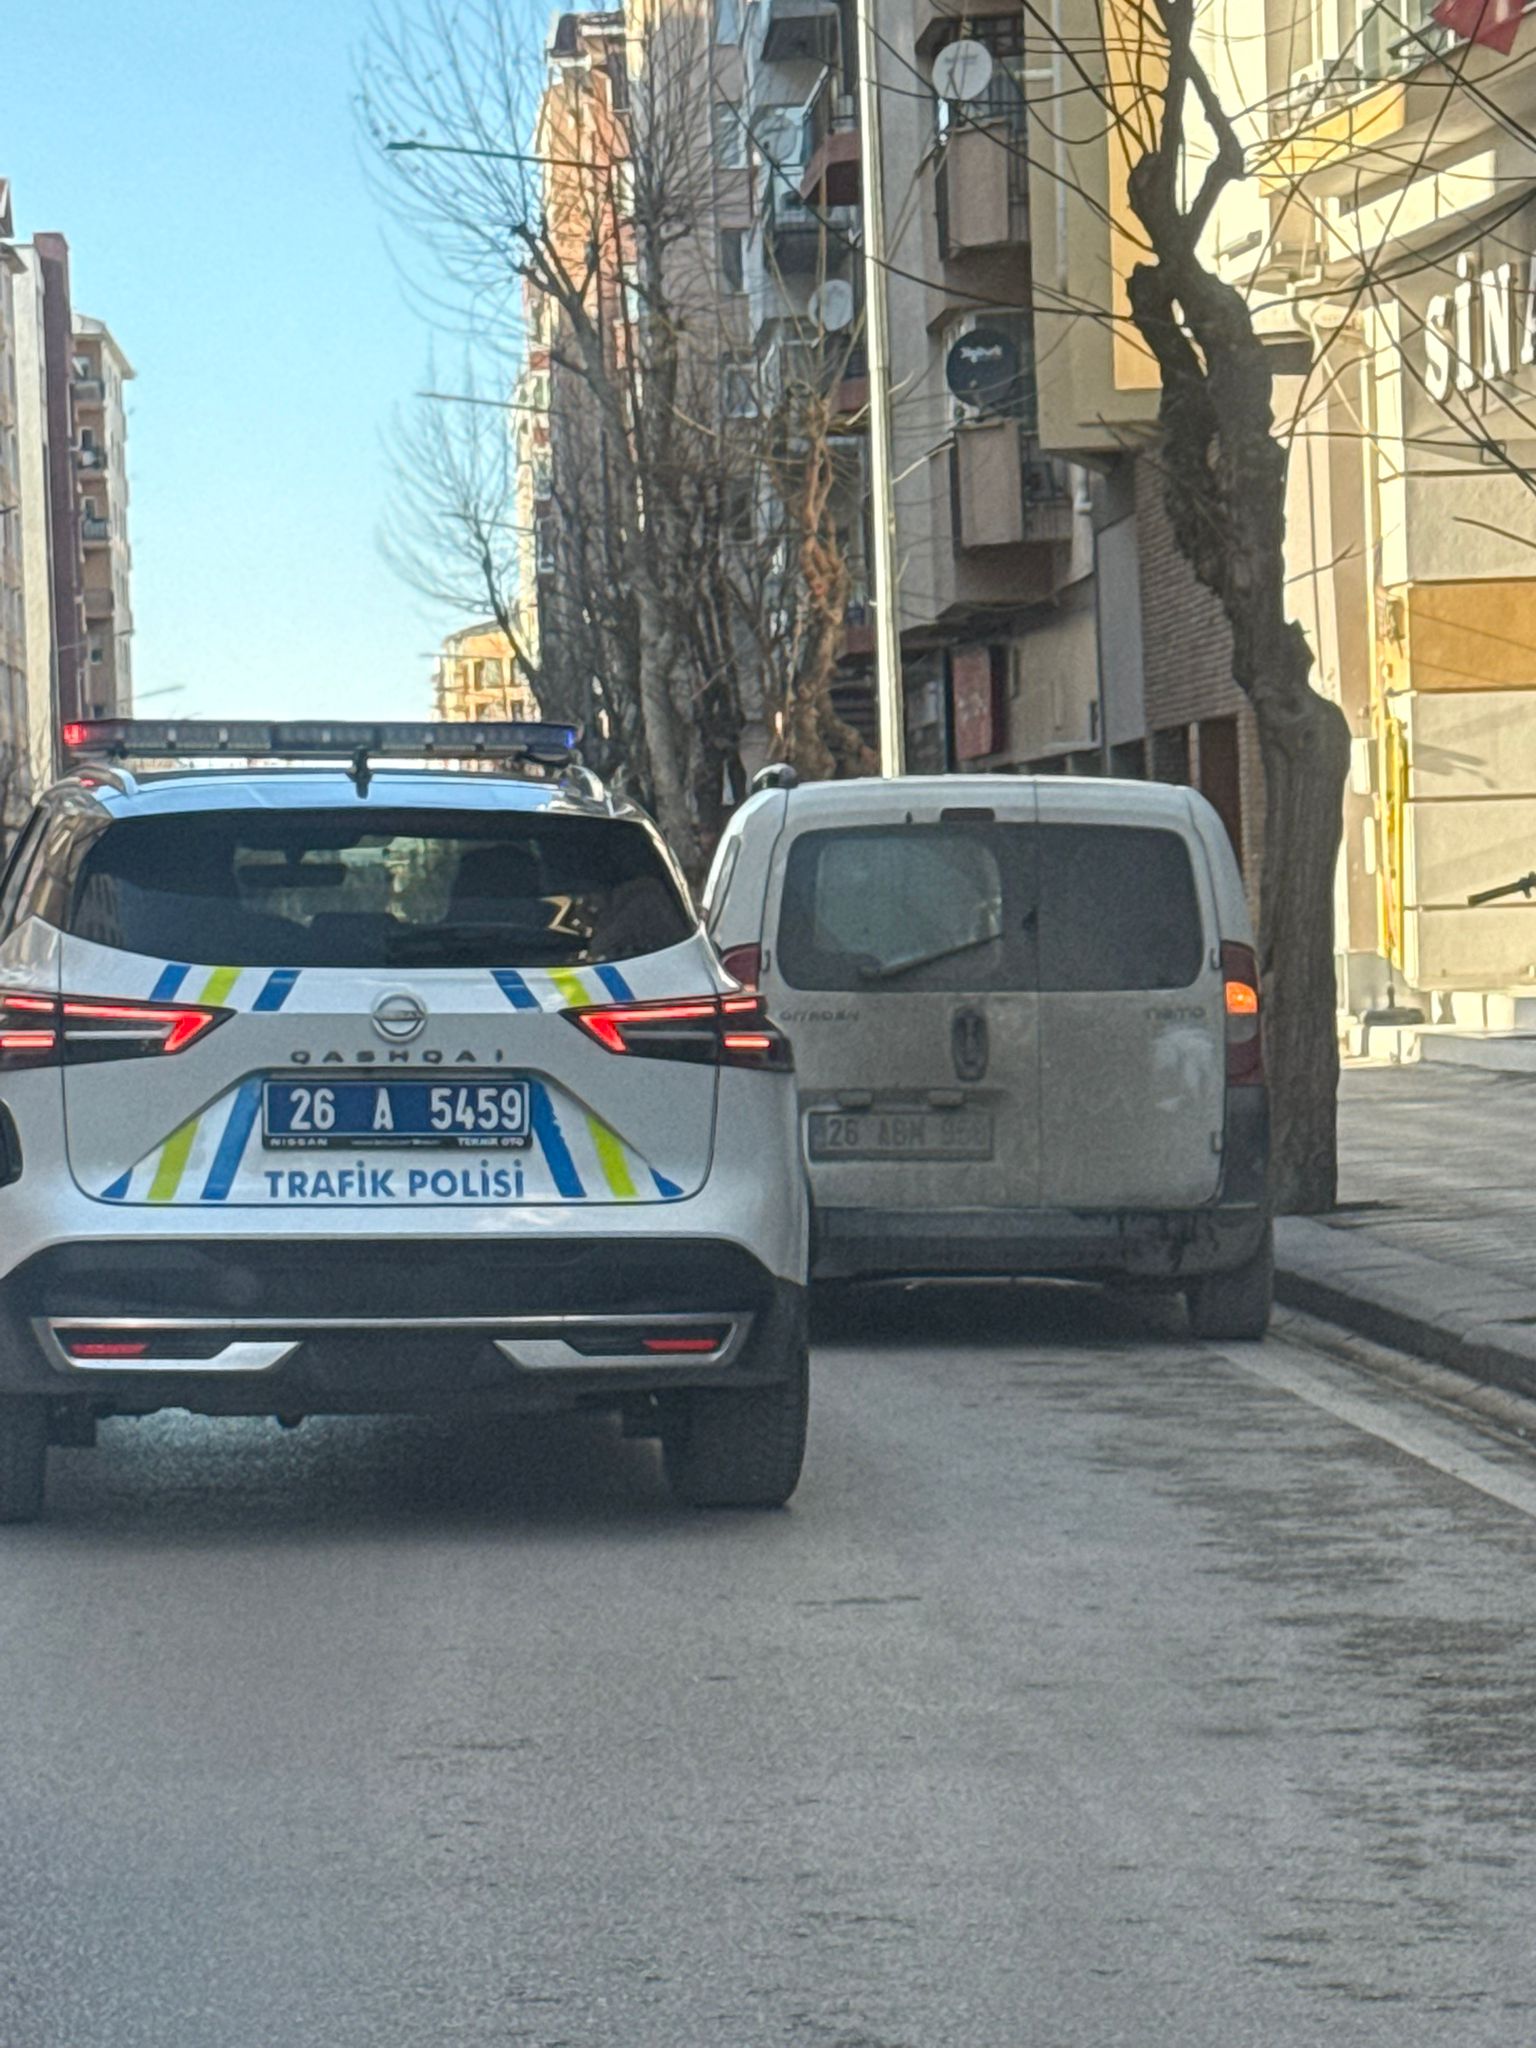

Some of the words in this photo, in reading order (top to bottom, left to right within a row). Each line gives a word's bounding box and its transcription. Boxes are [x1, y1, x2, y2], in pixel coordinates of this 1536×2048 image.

[290, 1050, 504, 1064] QASHQAI
[289, 1087, 336, 1130] 26
[372, 1087, 394, 1130] A
[430, 1087, 523, 1130] 5459
[269, 1138, 328, 1147] NISSAN
[828, 1118, 859, 1147] 26
[264, 1160, 396, 1198] TRAFİK
[408, 1159, 524, 1198] POLİSİ
